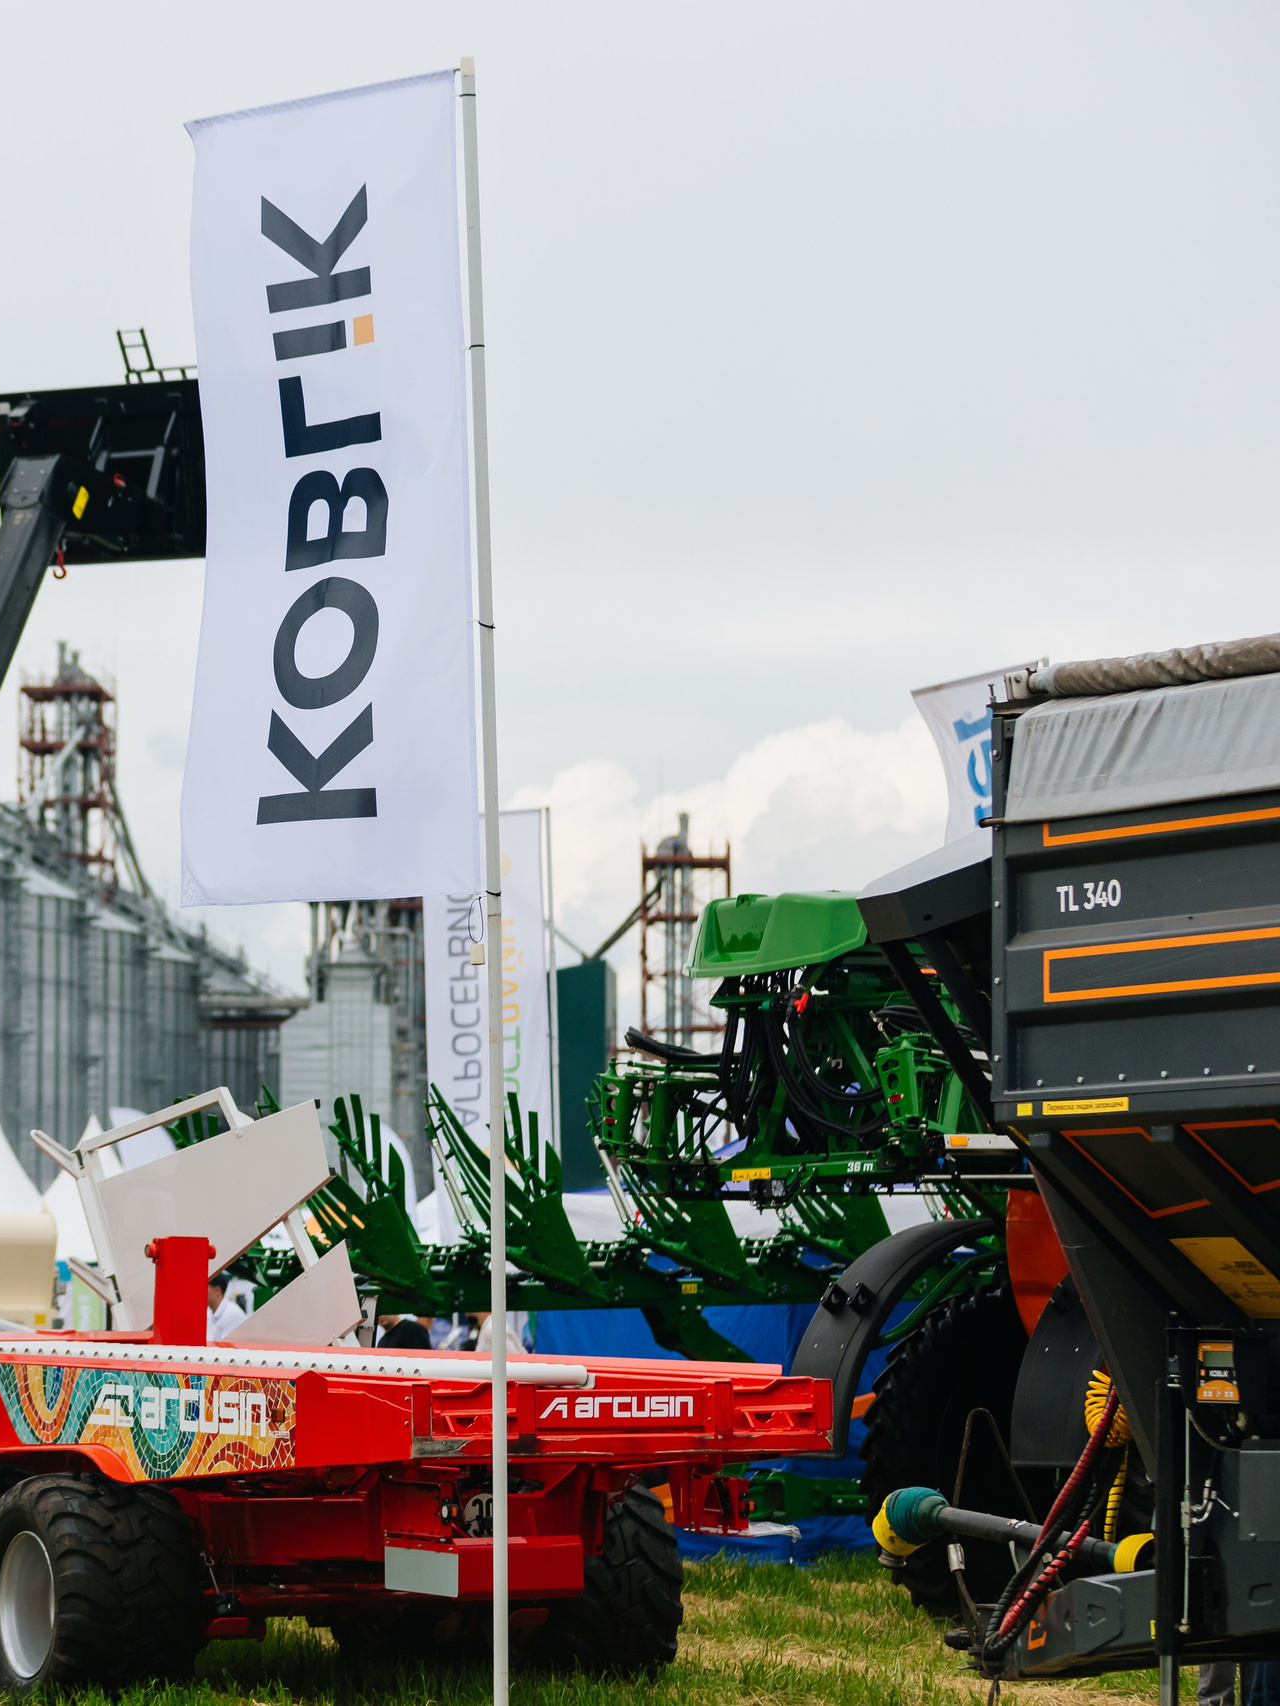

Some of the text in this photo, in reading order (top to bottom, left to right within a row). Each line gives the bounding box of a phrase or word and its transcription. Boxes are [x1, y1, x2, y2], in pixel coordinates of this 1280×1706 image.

[1056, 879, 1122, 913] TL 340
[141, 1386, 267, 1438] arcusin
[575, 1396, 693, 1418] arcusin
